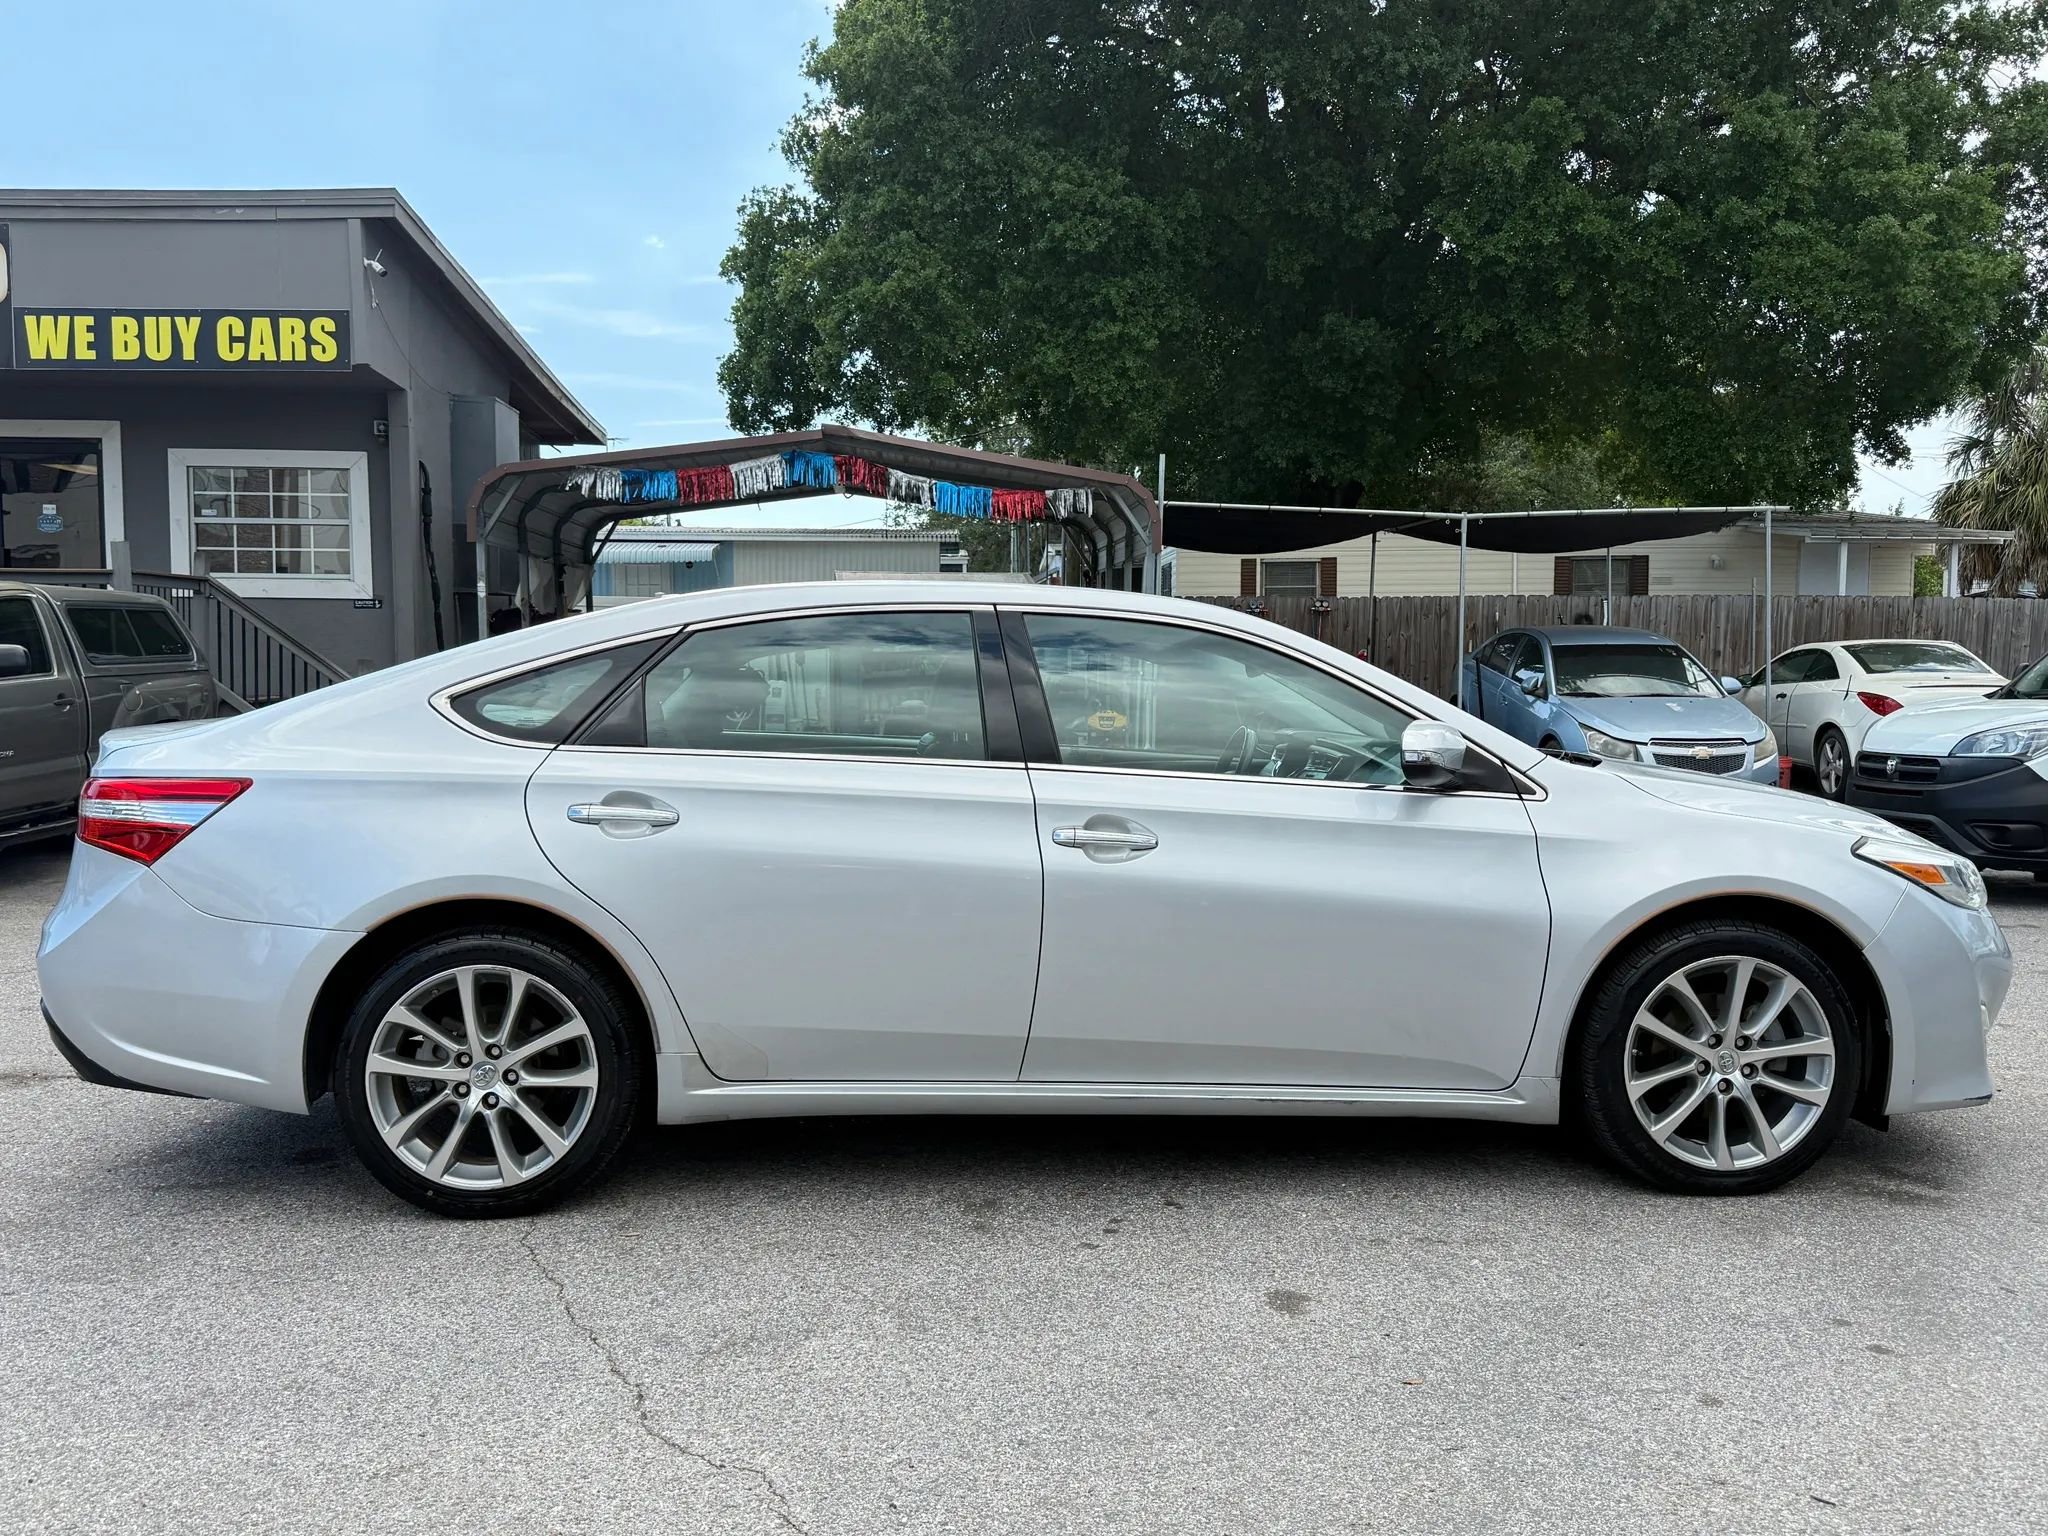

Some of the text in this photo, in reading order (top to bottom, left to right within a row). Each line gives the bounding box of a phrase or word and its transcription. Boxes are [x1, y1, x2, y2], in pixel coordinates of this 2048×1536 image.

[25, 316, 337, 362] WE BUY CARS
